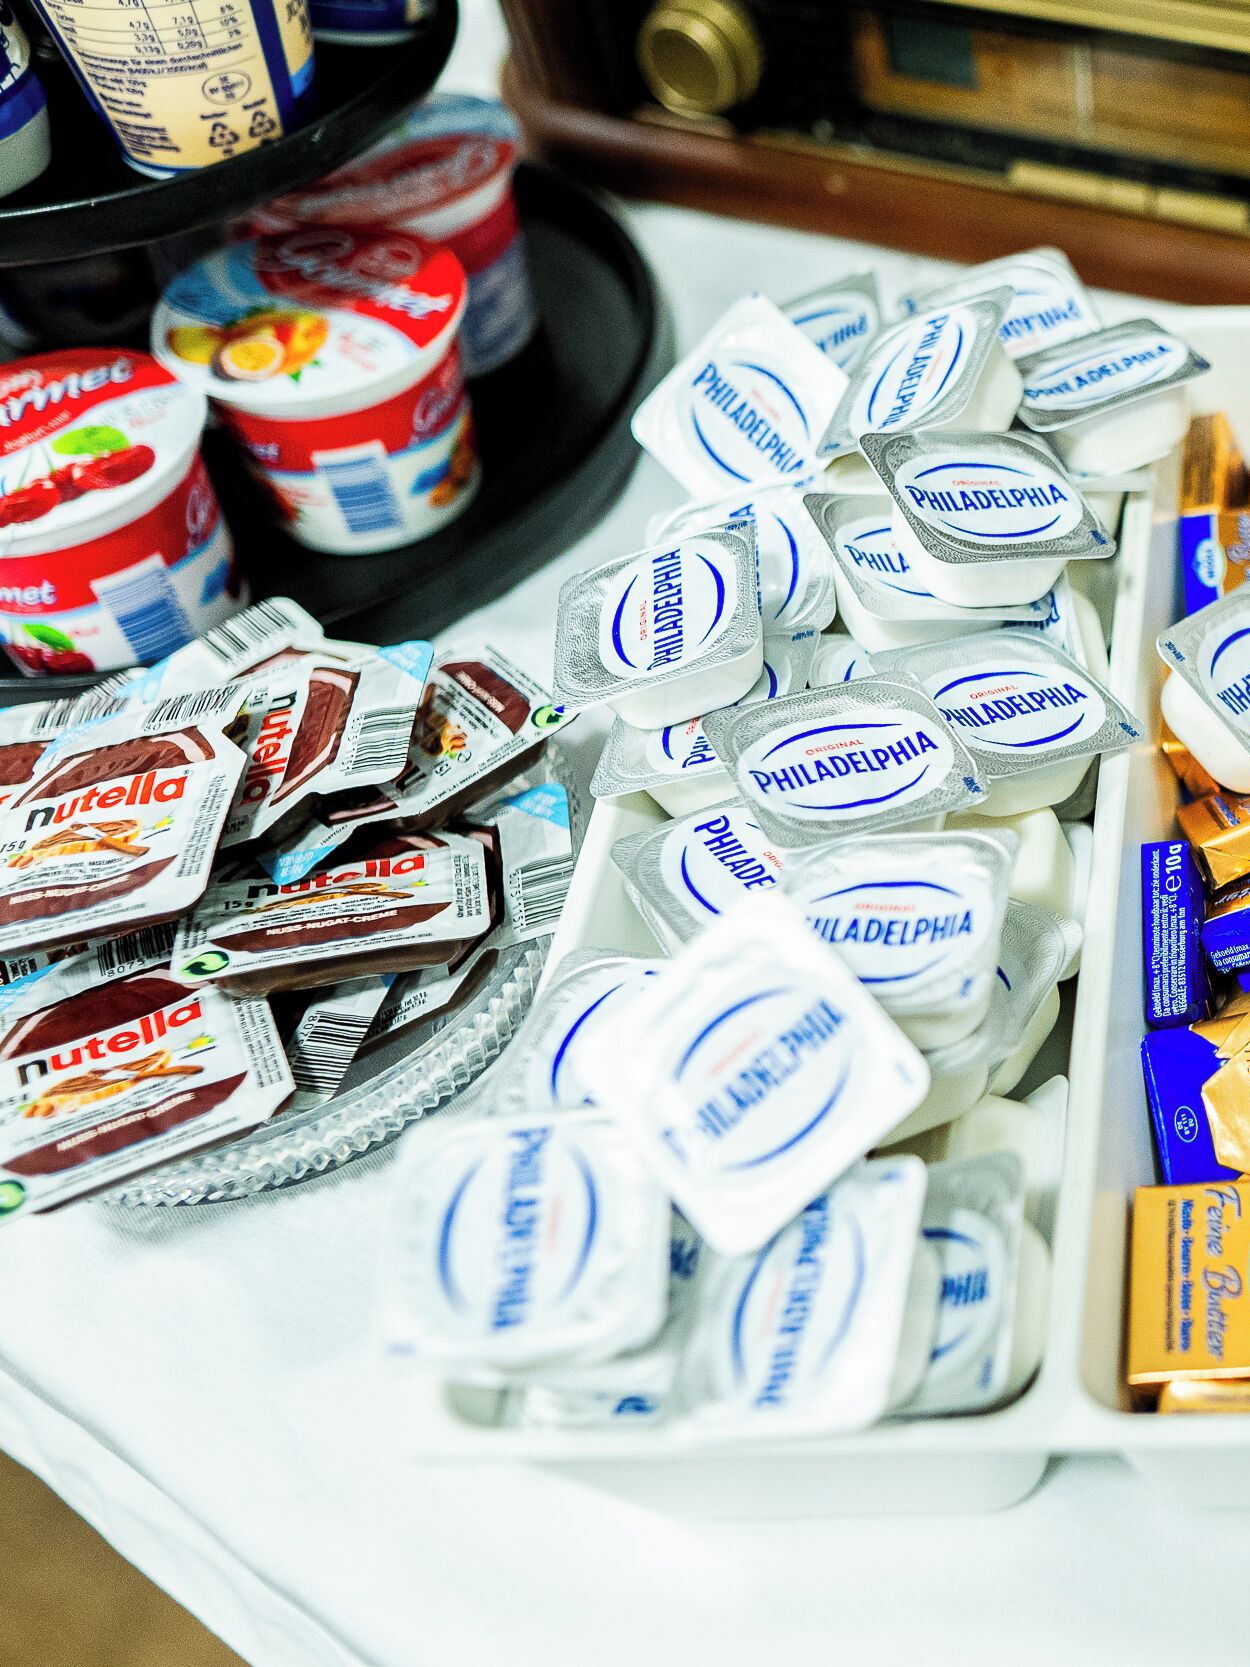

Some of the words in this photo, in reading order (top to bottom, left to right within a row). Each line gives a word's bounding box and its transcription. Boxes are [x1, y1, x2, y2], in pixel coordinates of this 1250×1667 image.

[878, 313, 951, 431] PHILADELPHIA
[1025, 344, 1173, 402] PHILADELPHIA
[693, 361, 808, 475] PHILADELPHIA
[904, 483, 1069, 513] PHILADELPHIA
[638, 599, 649, 641] ORIGINAL
[647, 547, 684, 671] PHILADELPHIA
[939, 683, 1088, 730] PHILADELPHIA
[969, 684, 1020, 700] ORIGINAL
[240, 690, 298, 805] nutella
[748, 730, 939, 794] PHILADELPHIA
[804, 737, 865, 757] ORIGINAL
[24, 771, 187, 832] nutella
[694, 814, 780, 893] PHILADE
[266, 910, 398, 935] NUSS-NUGAT-CREME
[1151, 926, 1162, 955] tenminste
[1177, 930, 1188, 966] Wasserburg
[1159, 973, 1171, 1007] consumarsi
[1177, 965, 1187, 985] 83512
[1162, 1008, 1171, 1017] Da
[16, 998, 202, 1086] nutella
[1204, 1185, 1242, 1258] Feine
[1202, 1264, 1243, 1360] Butter
